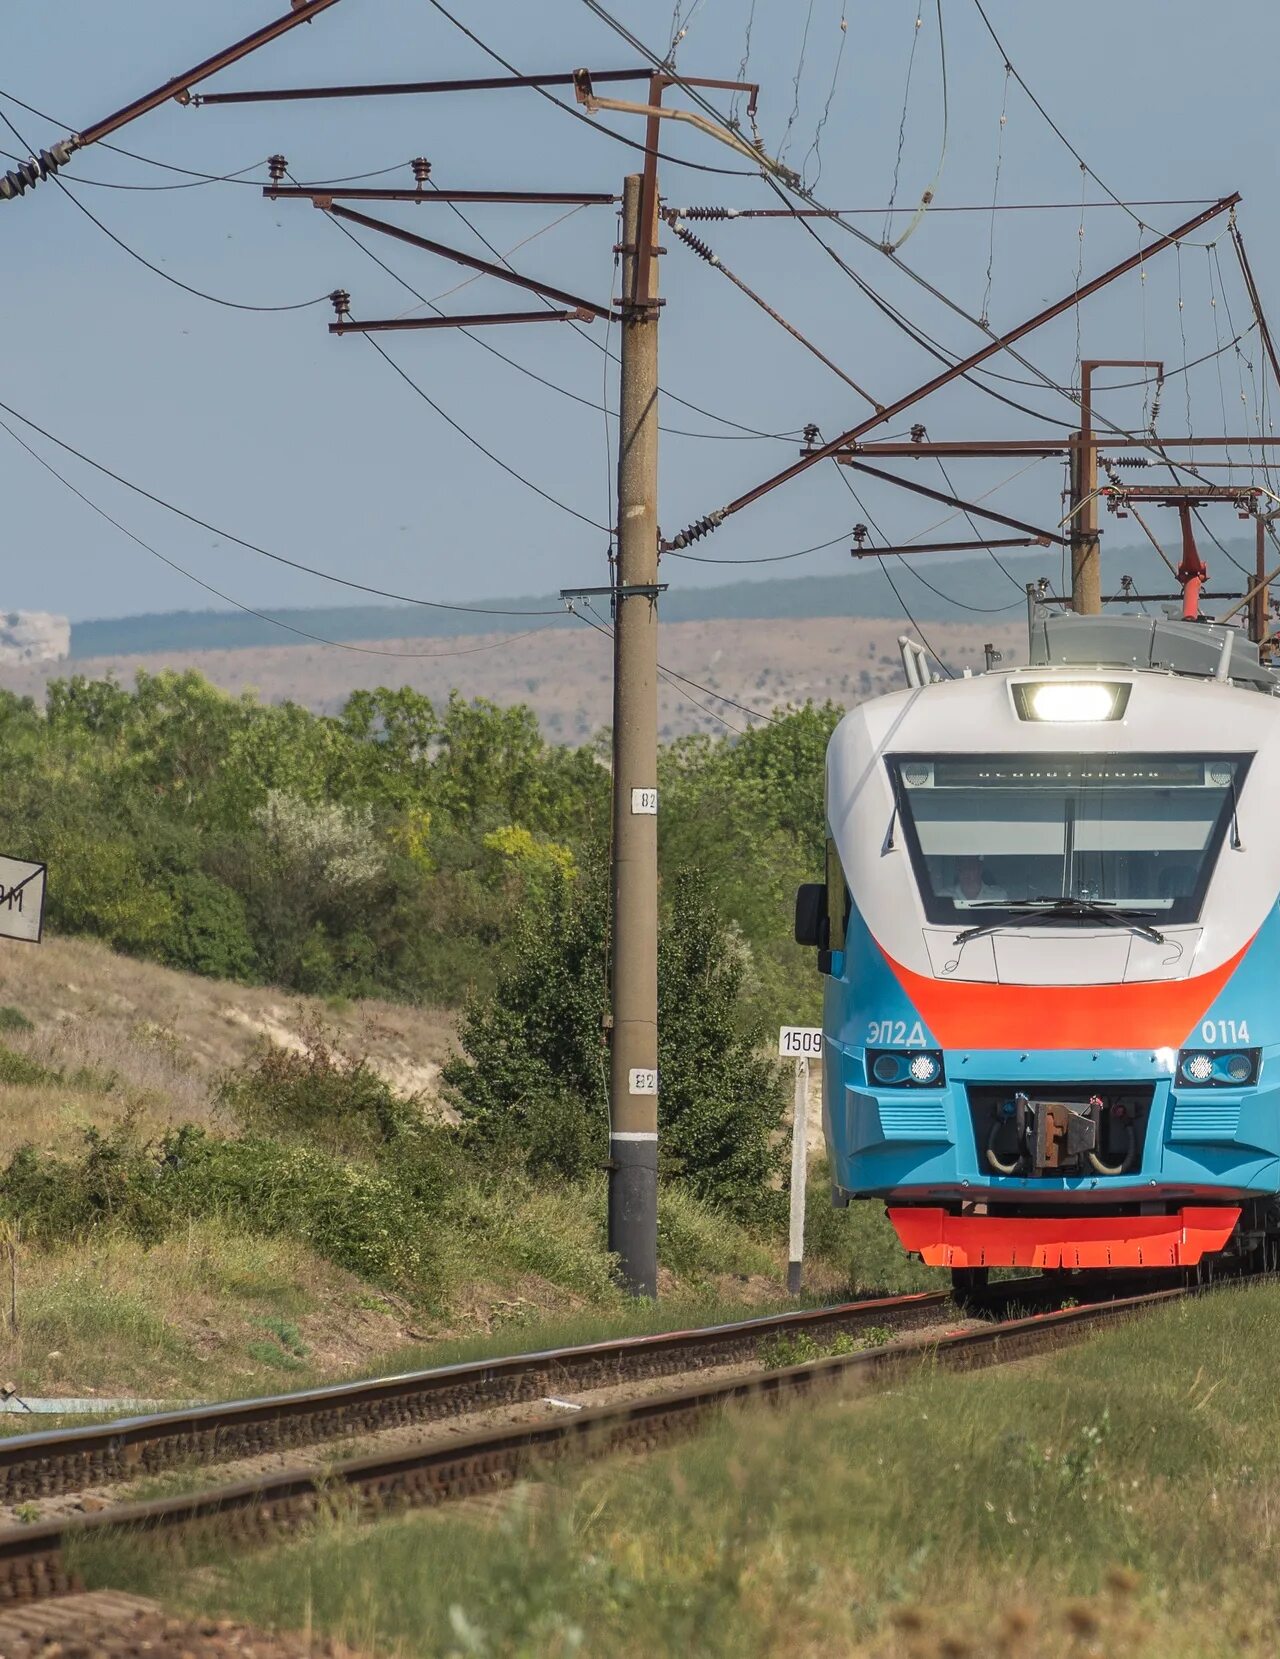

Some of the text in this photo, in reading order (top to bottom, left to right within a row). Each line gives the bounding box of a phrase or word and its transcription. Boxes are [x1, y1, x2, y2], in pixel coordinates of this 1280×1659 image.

[642, 793, 655, 808] 82
[784, 1032, 822, 1052] 1509
[866, 1021, 927, 1047] ЭП2Д
[1202, 1020, 1249, 1044] 0114
[636, 1074, 653, 1088] 82
